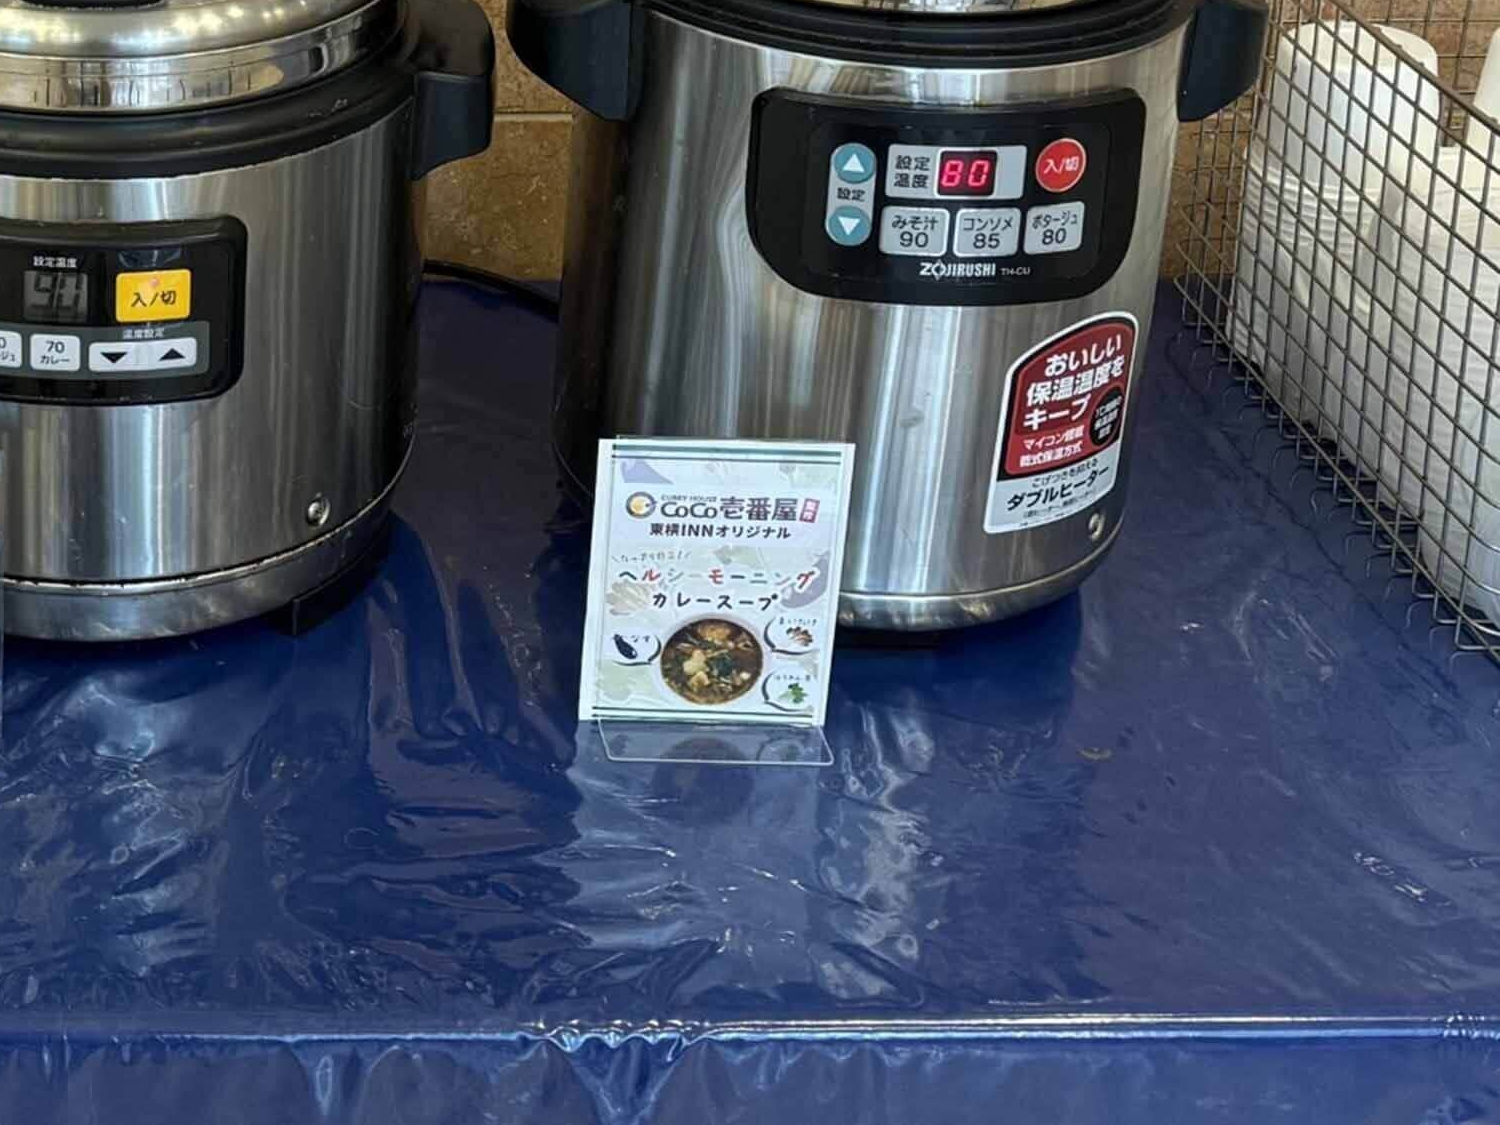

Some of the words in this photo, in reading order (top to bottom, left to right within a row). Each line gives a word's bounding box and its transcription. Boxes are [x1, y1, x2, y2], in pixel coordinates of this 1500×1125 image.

[895, 155, 931, 171] 設定
[1043, 156, 1080, 174] 入/切
[894, 173, 930, 189] 温度
[940, 159, 990, 188] 80
[837, 187, 866, 202] 設定
[891, 215, 938, 231] みそ汁
[963, 216, 1013, 231] コンソメ
[1031, 210, 1078, 229] ポタージュ
[899, 232, 929, 248] 90
[973, 232, 1001, 249] 85
[1042, 228, 1067, 245] 80
[920, 259, 996, 280] ZOJIRUSHI
[131, 289, 177, 308] 入/切
[45, 340, 65, 354] 70
[1045, 334, 1122, 377] おいしい
[39, 354, 71, 366] カレー
[1026, 355, 1125, 406] 保温温度を
[1023, 393, 1090, 431] キープ
[1007, 466, 1109, 511] ダブルヒーター
[650, 523, 791, 539] 東横INNオリジナル
[653, 592, 779, 611] カレースープ
